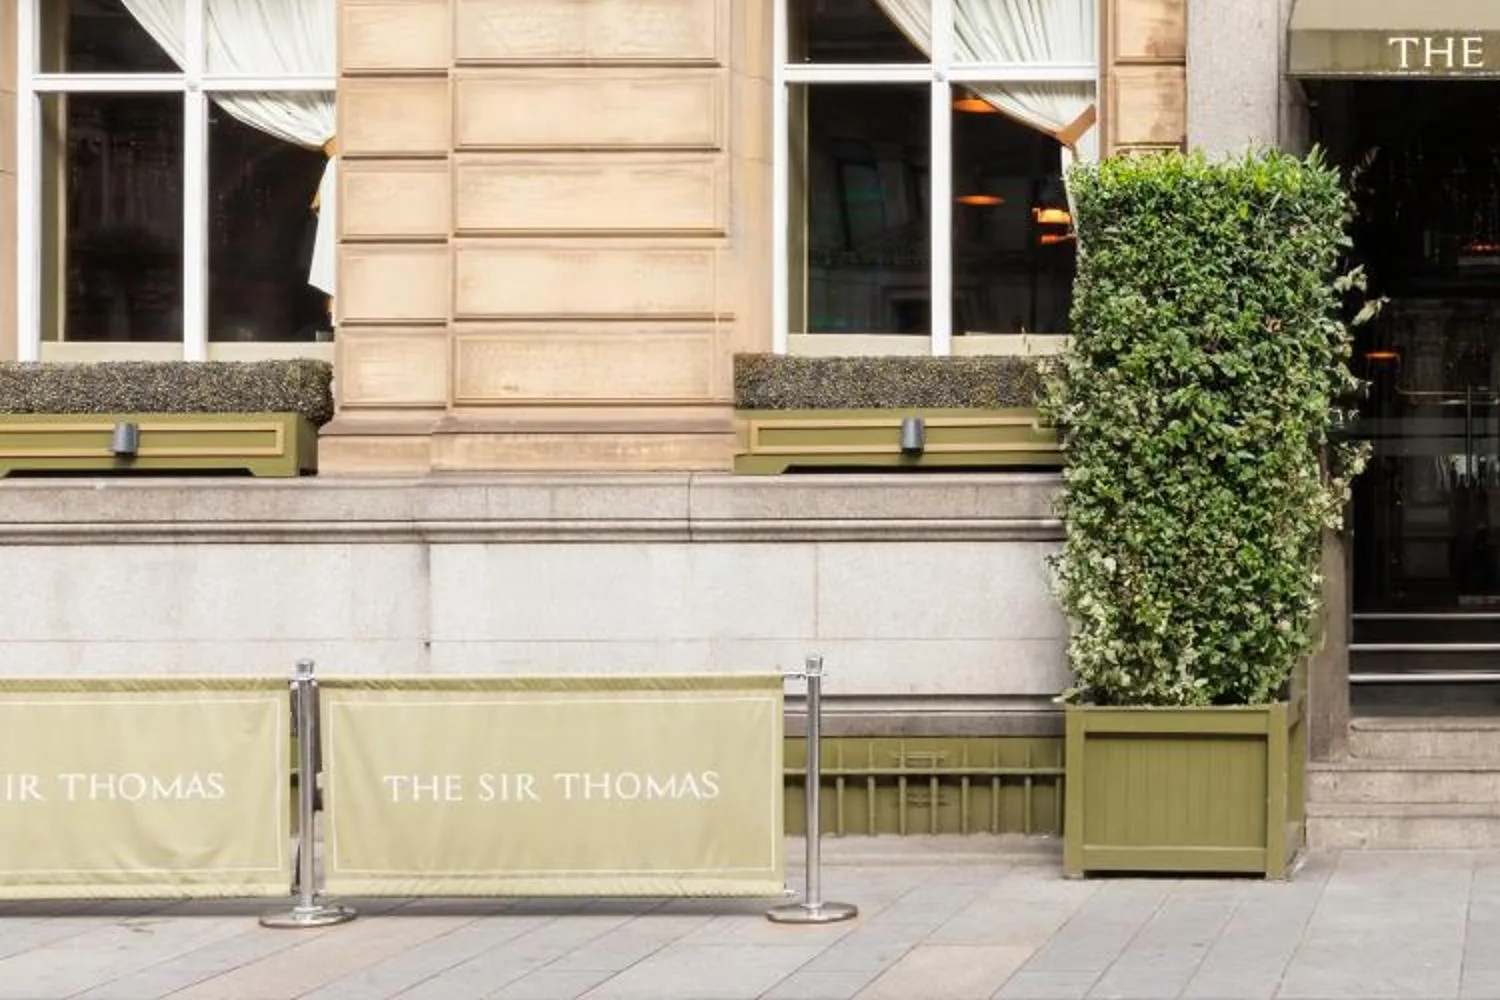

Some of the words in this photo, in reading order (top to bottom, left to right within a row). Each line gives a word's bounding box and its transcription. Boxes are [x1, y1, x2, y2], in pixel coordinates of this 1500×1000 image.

[1388, 37, 1485, 69] THE
[6, 773, 47, 802] IR
[57, 771, 227, 802] THOMAS
[383, 774, 464, 803] THE
[478, 773, 542, 802] SIR
[554, 771, 721, 801] THOMAS
